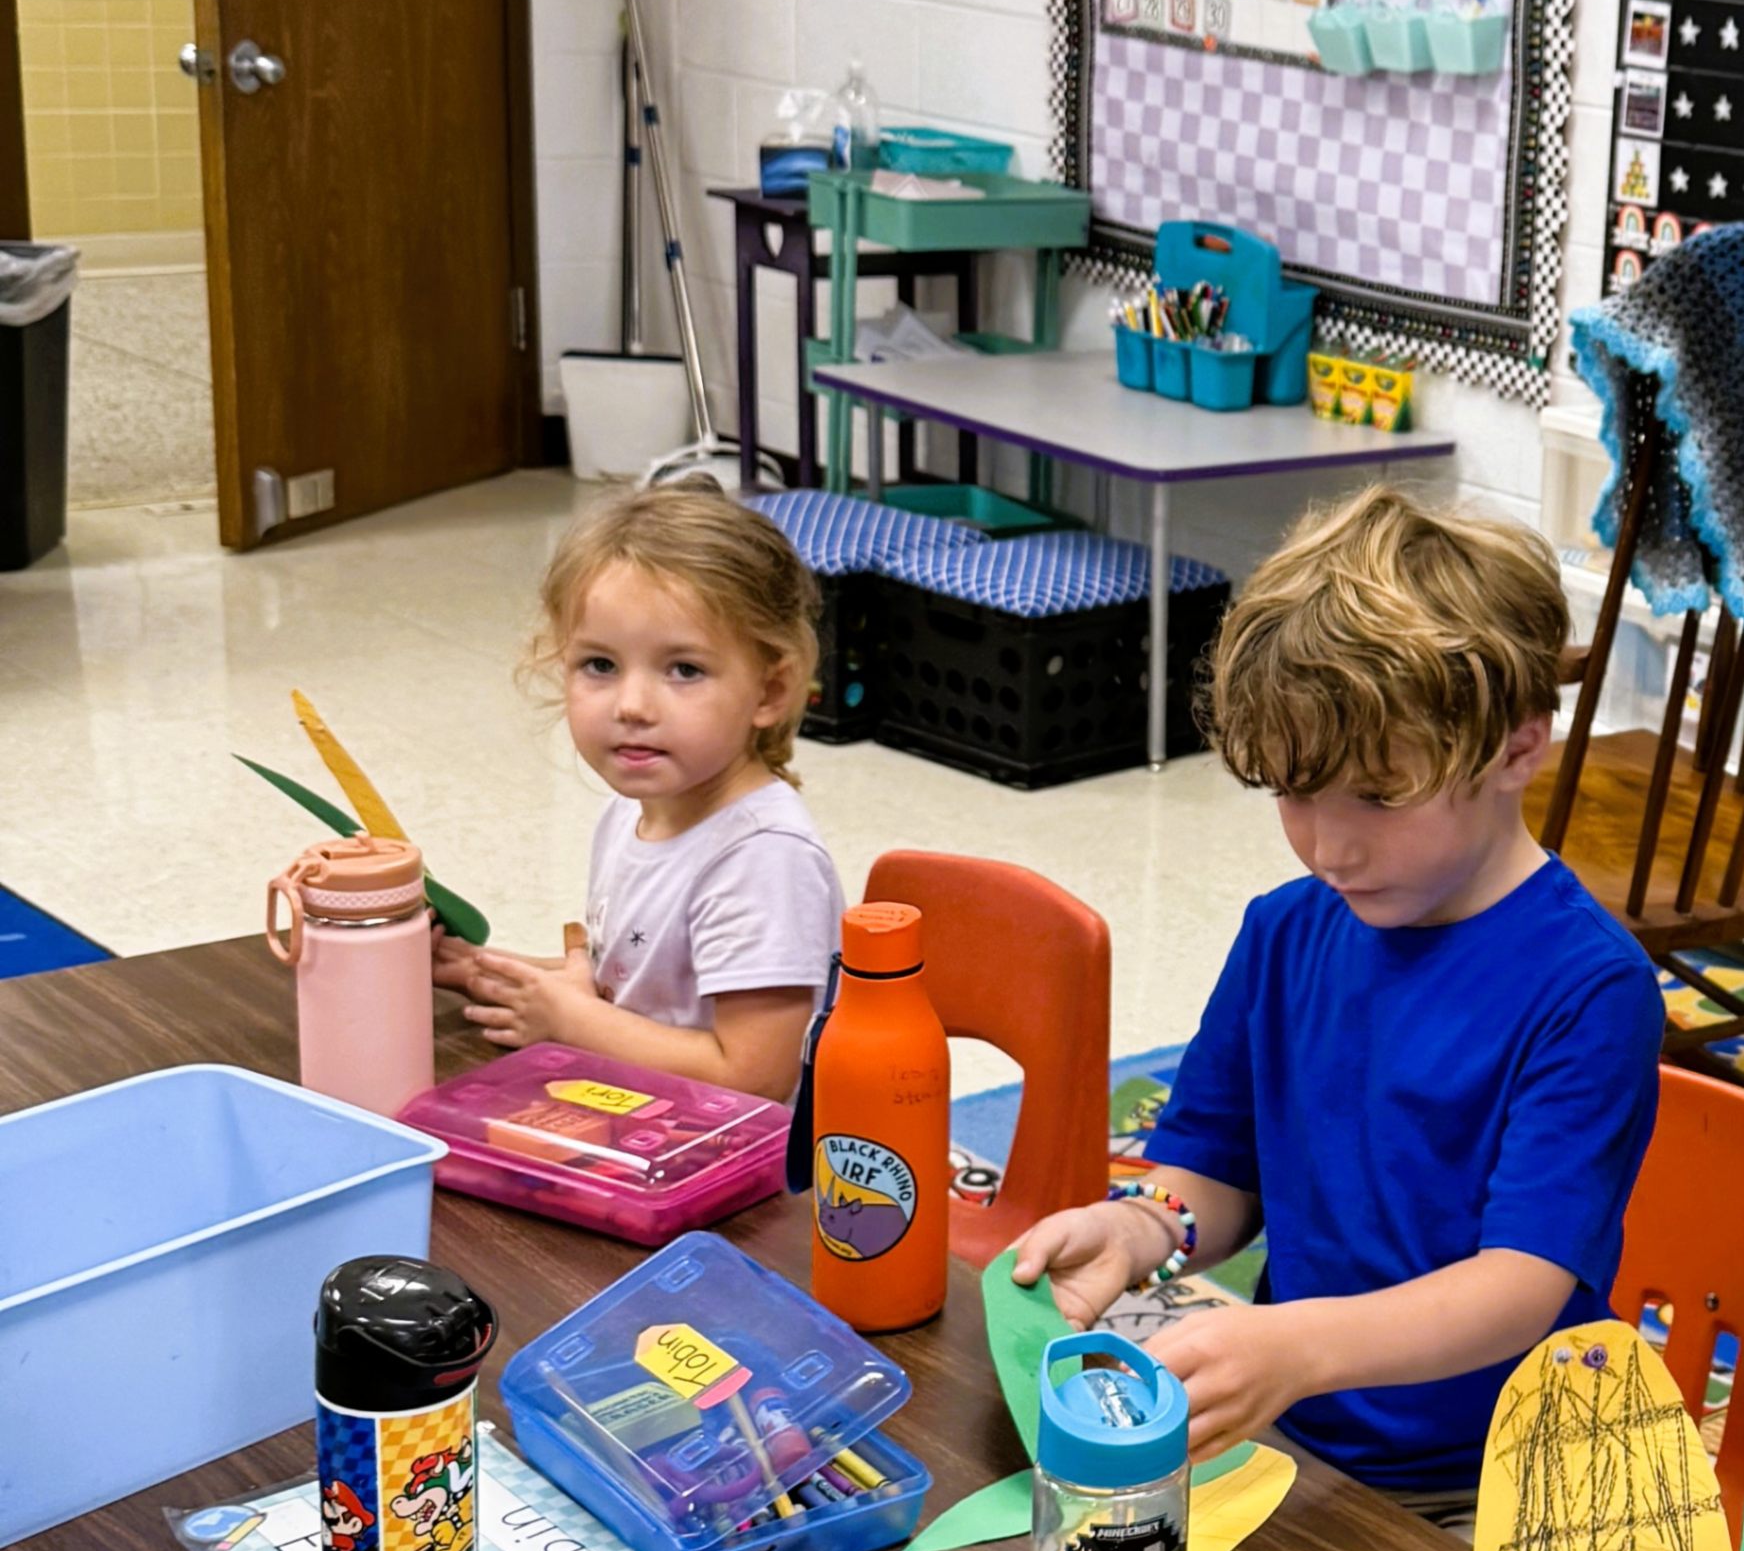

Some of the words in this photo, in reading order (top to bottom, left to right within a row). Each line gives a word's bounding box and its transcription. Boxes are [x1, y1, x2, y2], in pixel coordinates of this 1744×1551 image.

[1208, 0, 1226, 29] 30
[585, 1085, 634, 1108] Tori
[829, 1139, 882, 1161] BLACK
[881, 1155, 913, 1202] RHINO
[841, 1158, 883, 1186] IRF
[657, 1330, 718, 1387] Tobin
[1096, 1519, 1162, 1541] MINECRAFT
